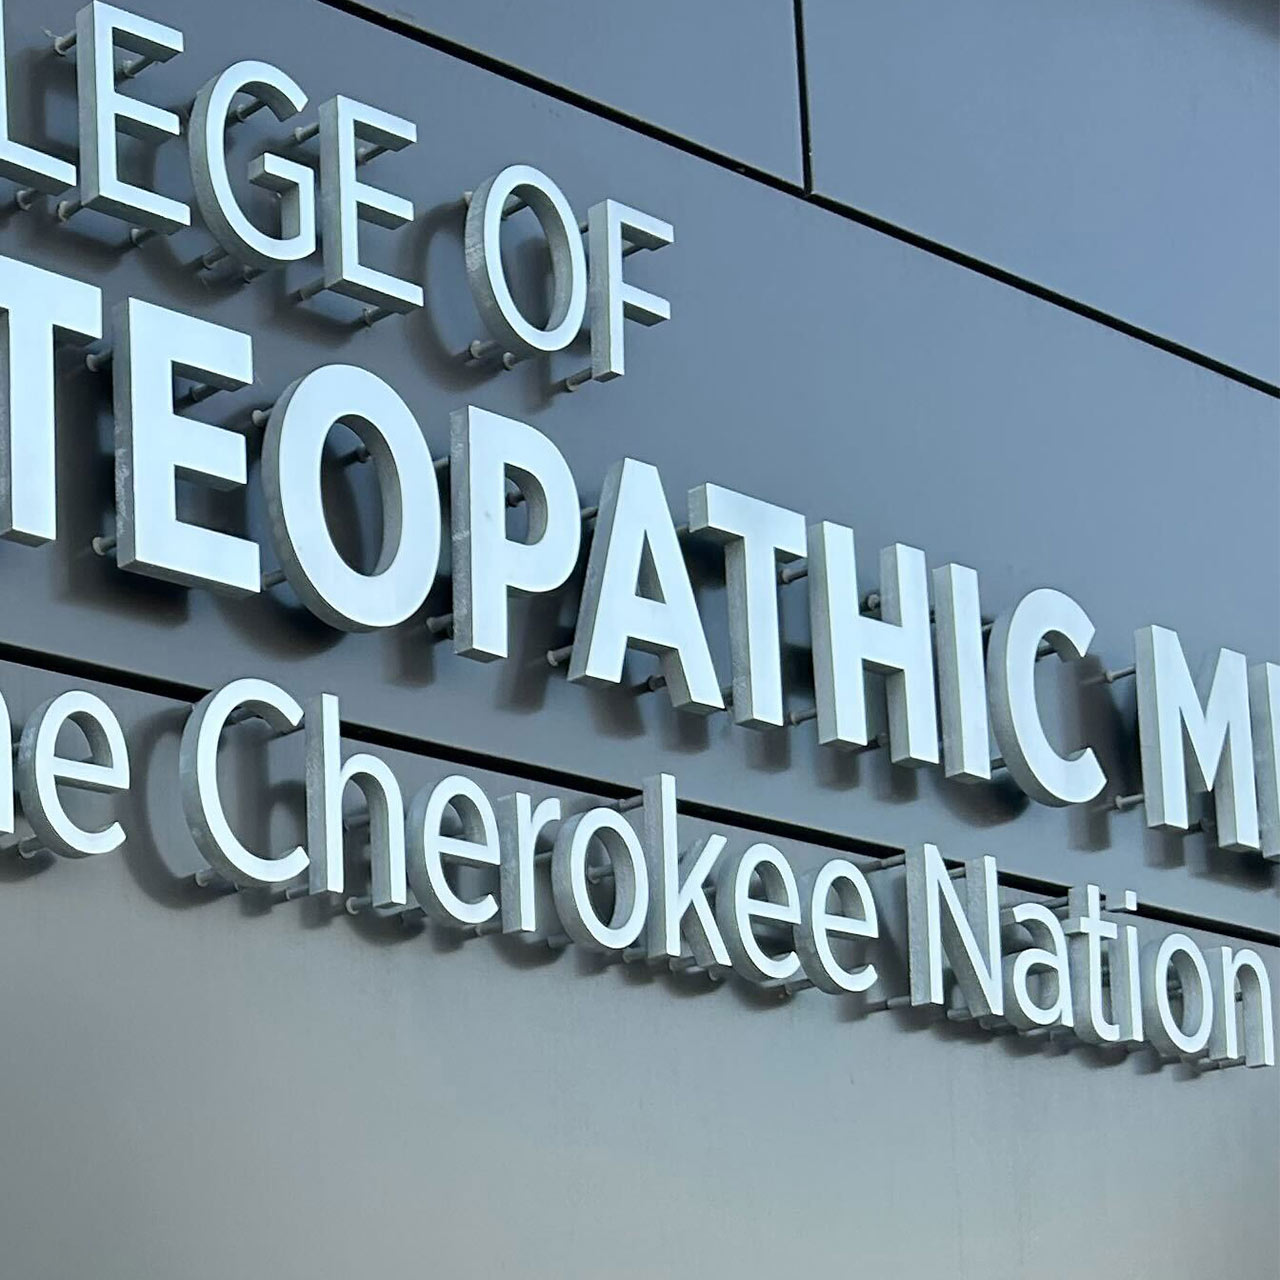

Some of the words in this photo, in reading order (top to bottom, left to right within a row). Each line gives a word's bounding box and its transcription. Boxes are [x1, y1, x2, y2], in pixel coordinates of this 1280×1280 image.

[465, 165, 674, 383] OF
[180, 677, 880, 995] Cherokee
[906, 842, 1276, 1068] Nation
